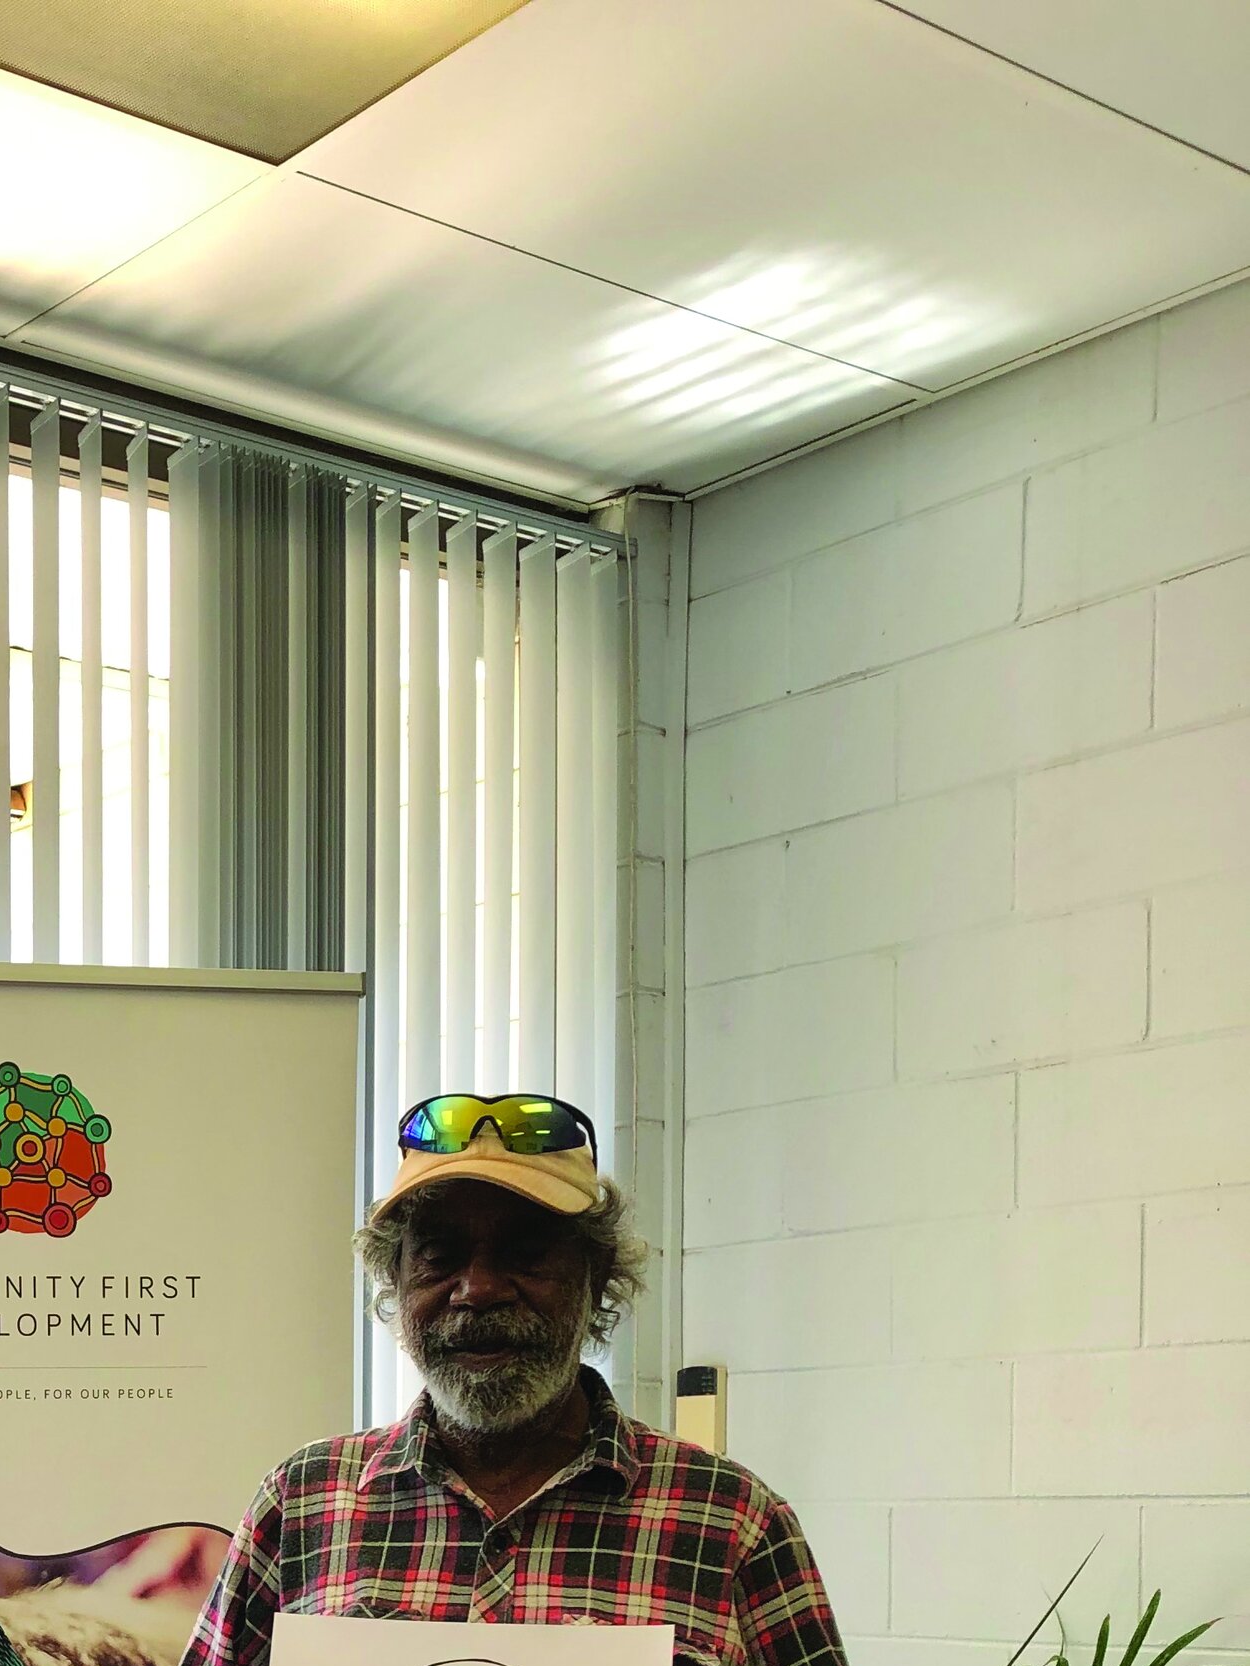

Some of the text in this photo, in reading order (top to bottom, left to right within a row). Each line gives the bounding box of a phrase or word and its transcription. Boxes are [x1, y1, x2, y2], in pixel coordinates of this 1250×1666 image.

[102, 1275, 202, 1299] FIRST
[44, 1388, 73, 1400] FOR
[80, 1388, 110, 1400] OUR
[118, 1387, 174, 1399] PEOPLE
